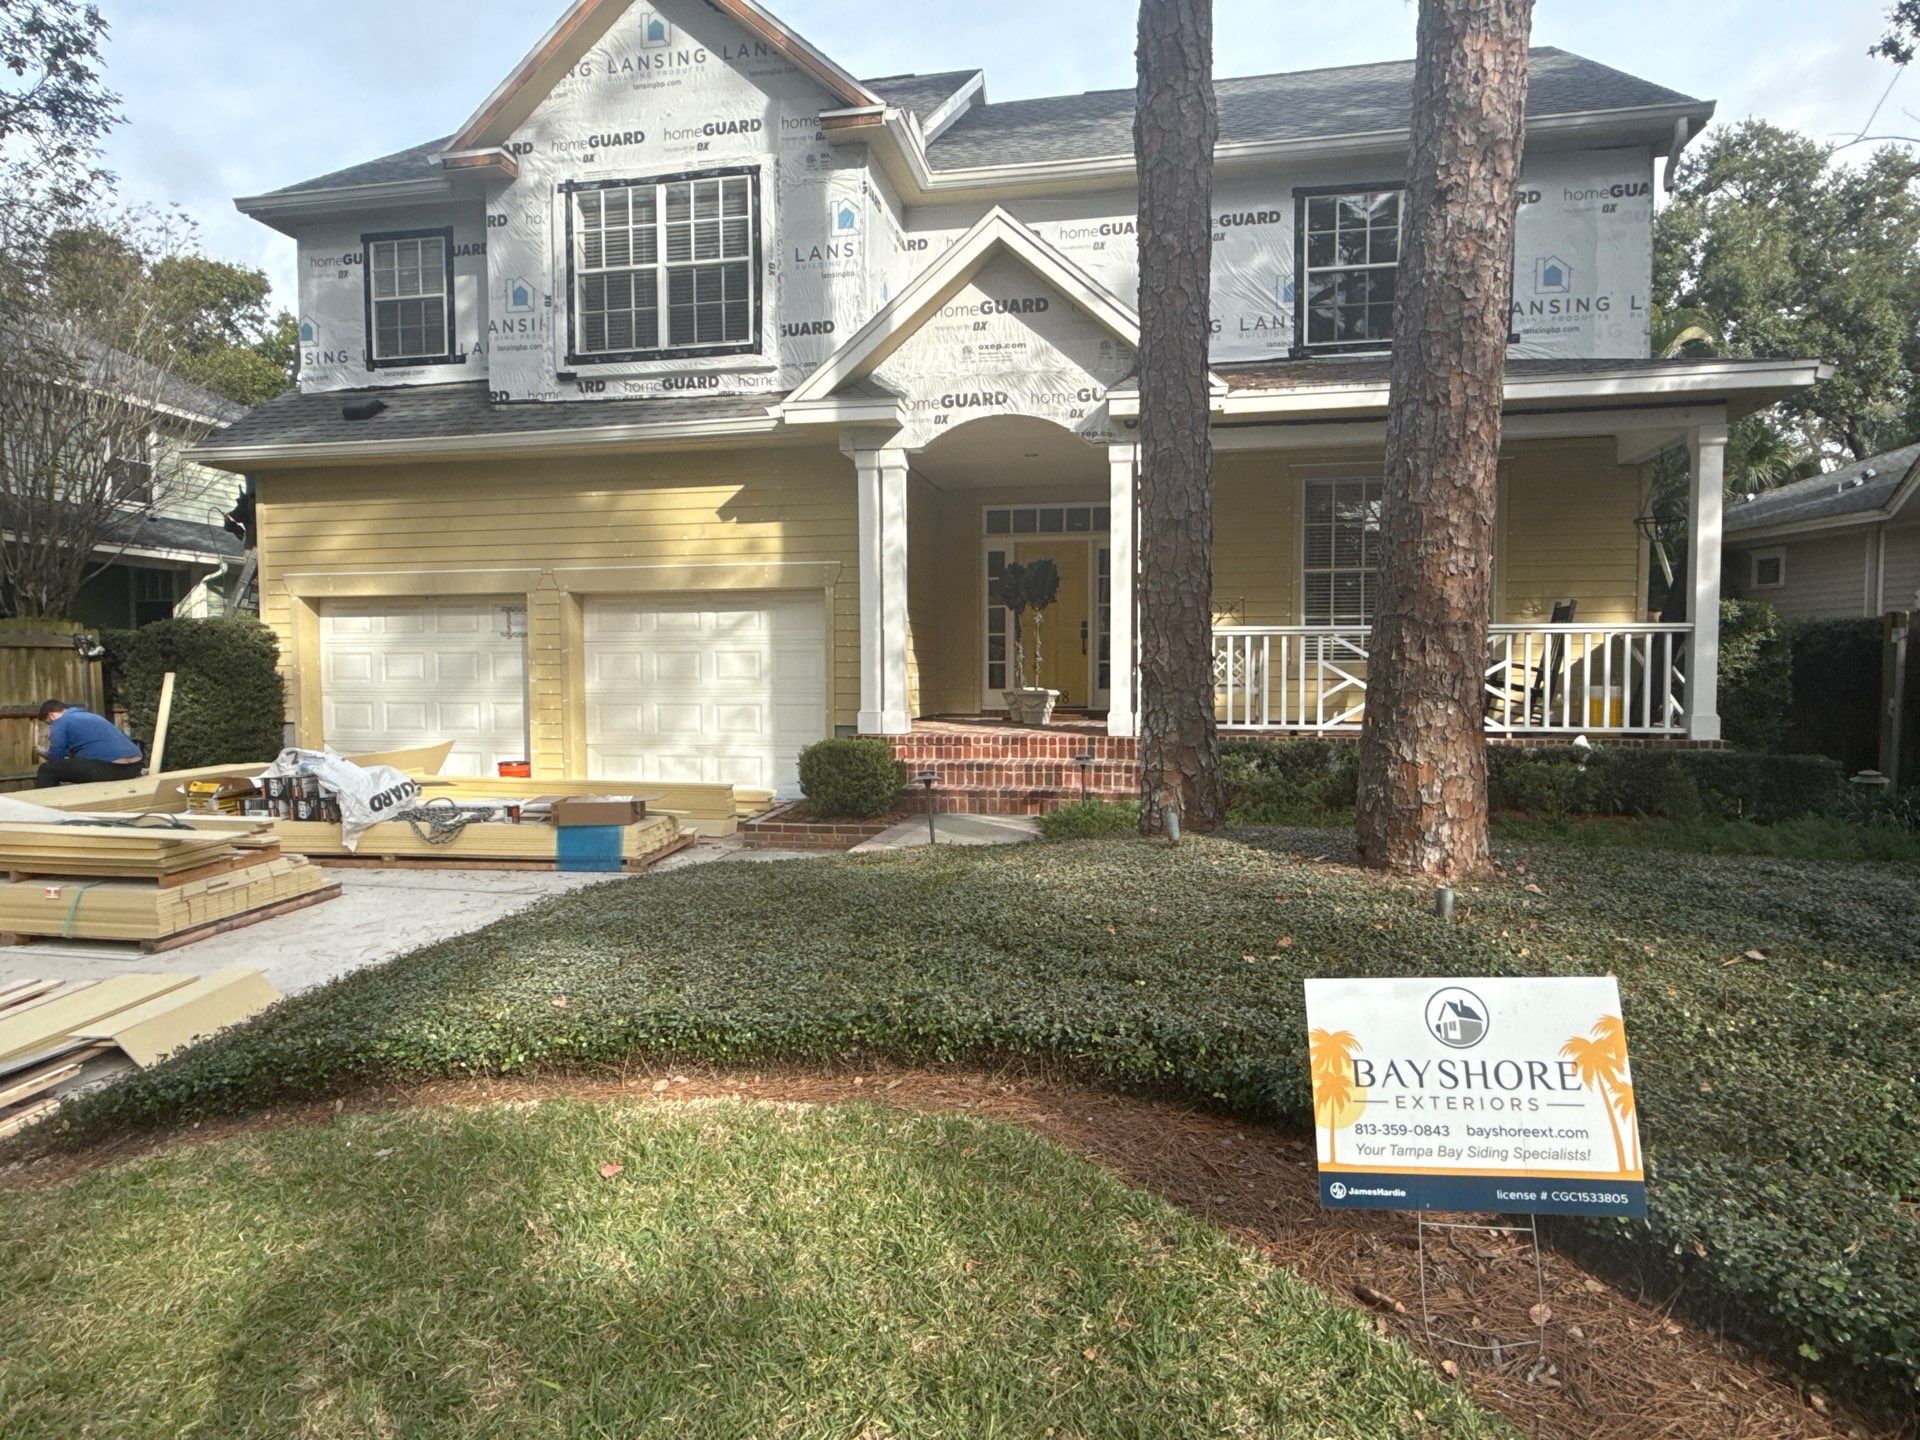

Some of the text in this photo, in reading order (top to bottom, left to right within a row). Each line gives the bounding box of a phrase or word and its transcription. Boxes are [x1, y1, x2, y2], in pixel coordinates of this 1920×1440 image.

[608, 48, 706, 75] LANSING
[551, 130, 645, 152] homeGUARD
[663, 118, 762, 141] homeGUARD
[934, 297, 1049, 319] homeGUARD
[624, 375, 719, 392] homeGUARD
[1351, 1058, 1583, 1091] BAYSHORE
[1395, 1095, 1540, 1112] EXTERIORS
[1355, 1123, 1589, 1139] 813-359-0843 bayshoreext.com
[1356, 1143, 1591, 1162] Your Tampa Bay Siding Specialists!
[1348, 1187, 1406, 1197] JamesHardie
[1496, 1189, 1537, 1200] license
[1540, 1190, 1548, 1201] #
[1551, 1191, 1629, 1204] CGC1533805
